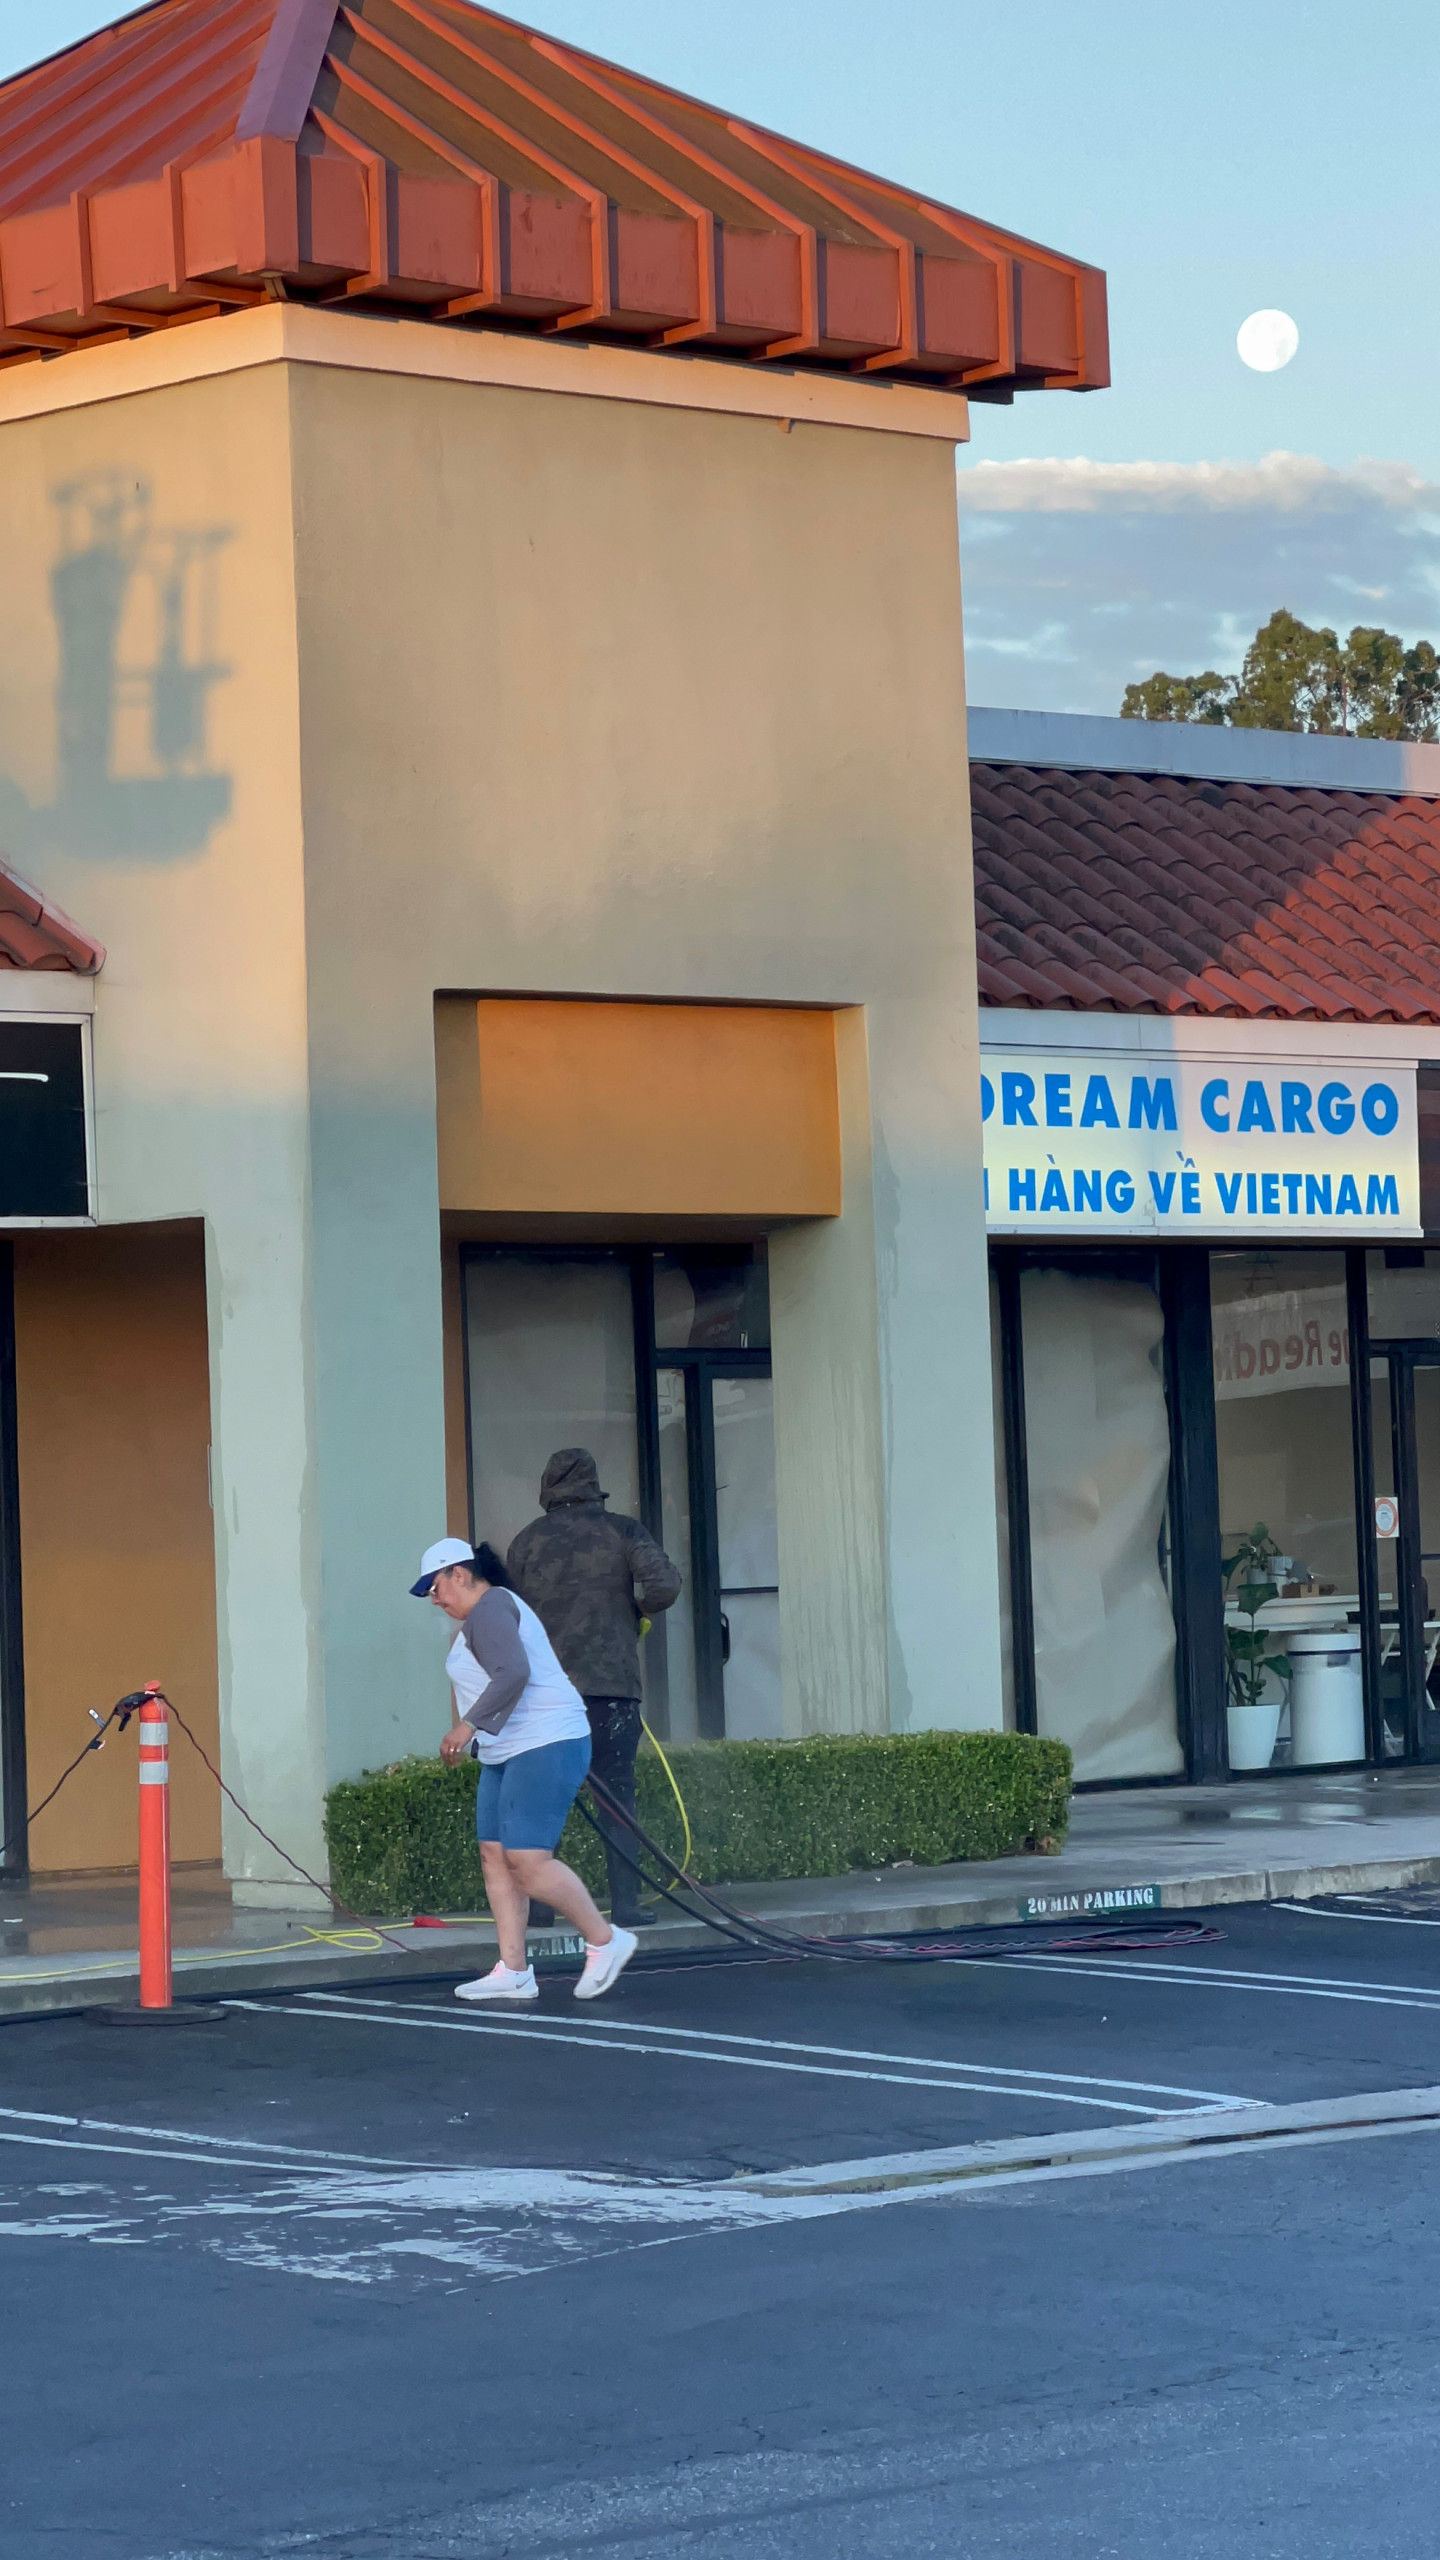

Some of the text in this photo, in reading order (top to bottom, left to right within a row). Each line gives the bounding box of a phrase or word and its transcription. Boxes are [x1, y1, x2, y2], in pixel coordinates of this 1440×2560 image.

[1200, 1079, 1399, 1136] CARGO
[1008, 1154, 1136, 1213] HÀNG
[1148, 1151, 1200, 1214] VỀ
[1214, 1172, 1400, 1215] VIETNAM
[1027, 1887, 1153, 1914] 20 MIN PARKING
